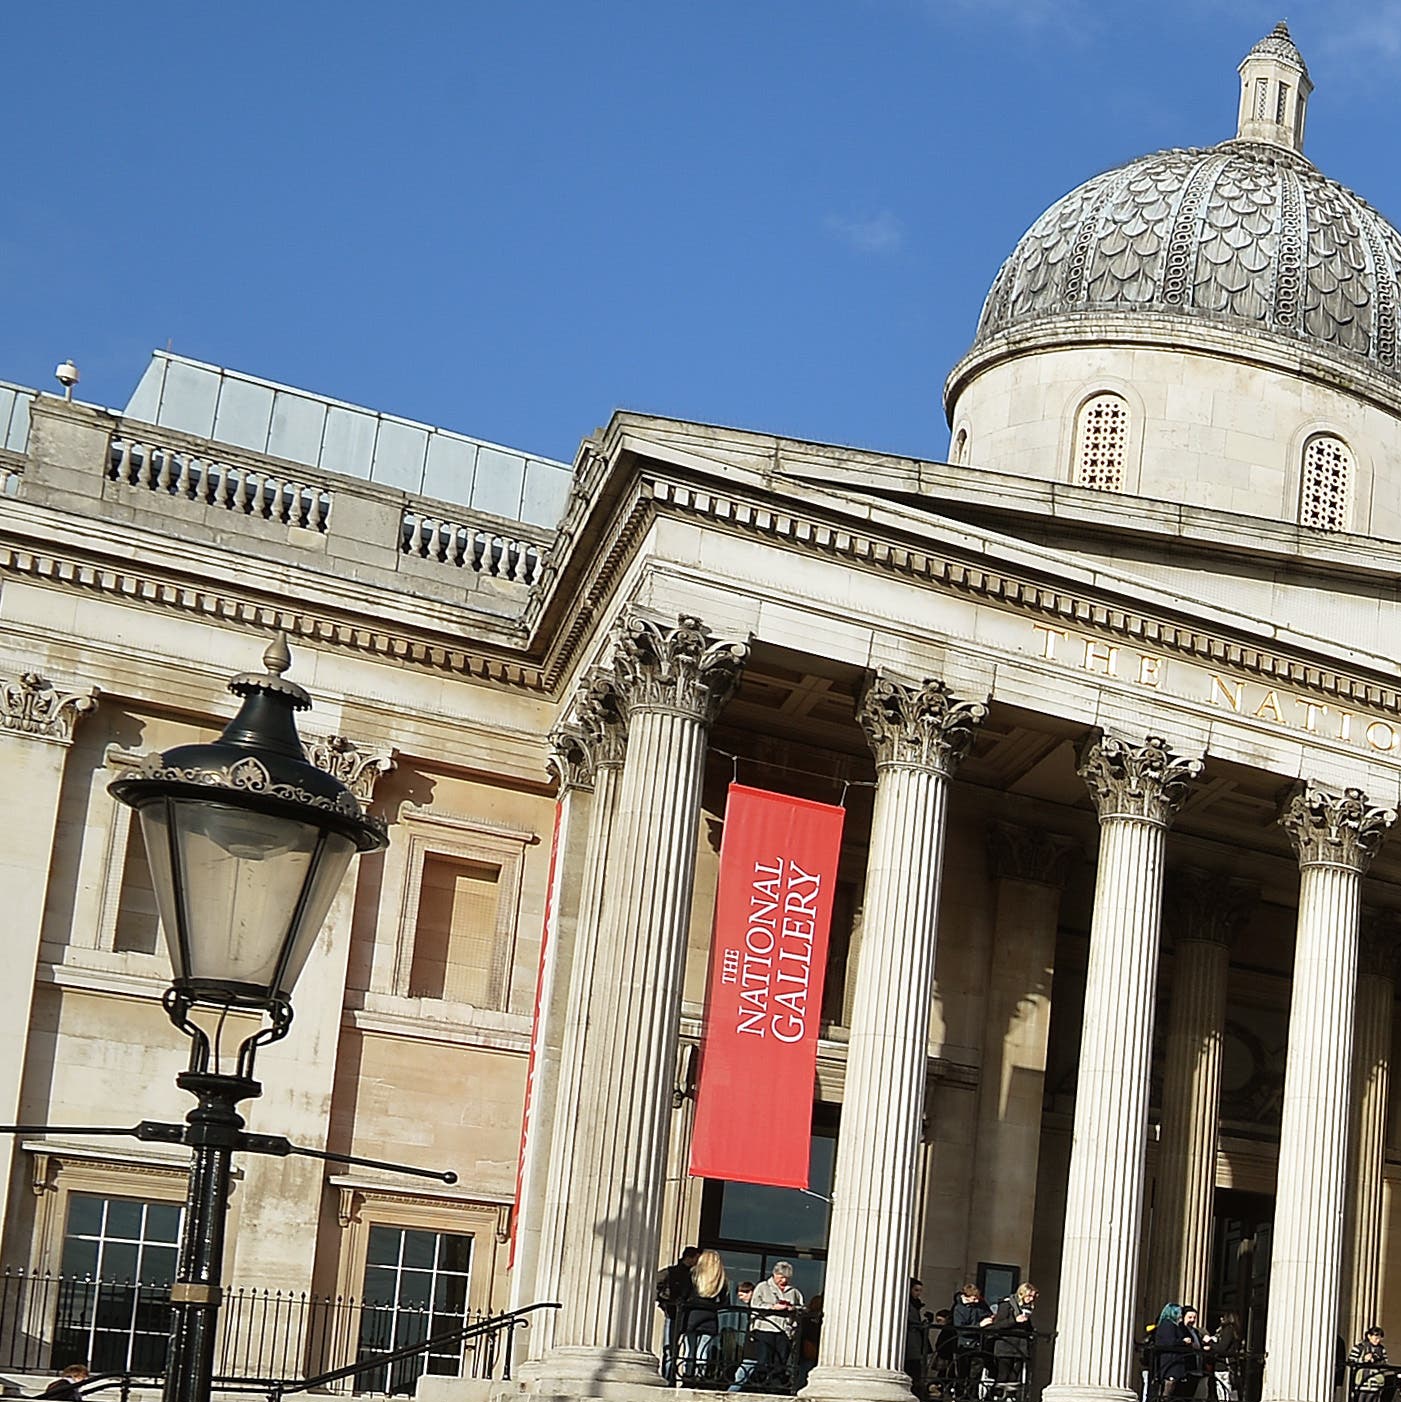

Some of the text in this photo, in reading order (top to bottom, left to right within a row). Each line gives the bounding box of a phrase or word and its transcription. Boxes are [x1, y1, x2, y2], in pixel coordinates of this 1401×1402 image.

[1032, 623, 1163, 689] THE
[721, 948, 740, 985] THE
[736, 856, 784, 1038] NATIONAL
[770, 859, 821, 1044] GALLERY
